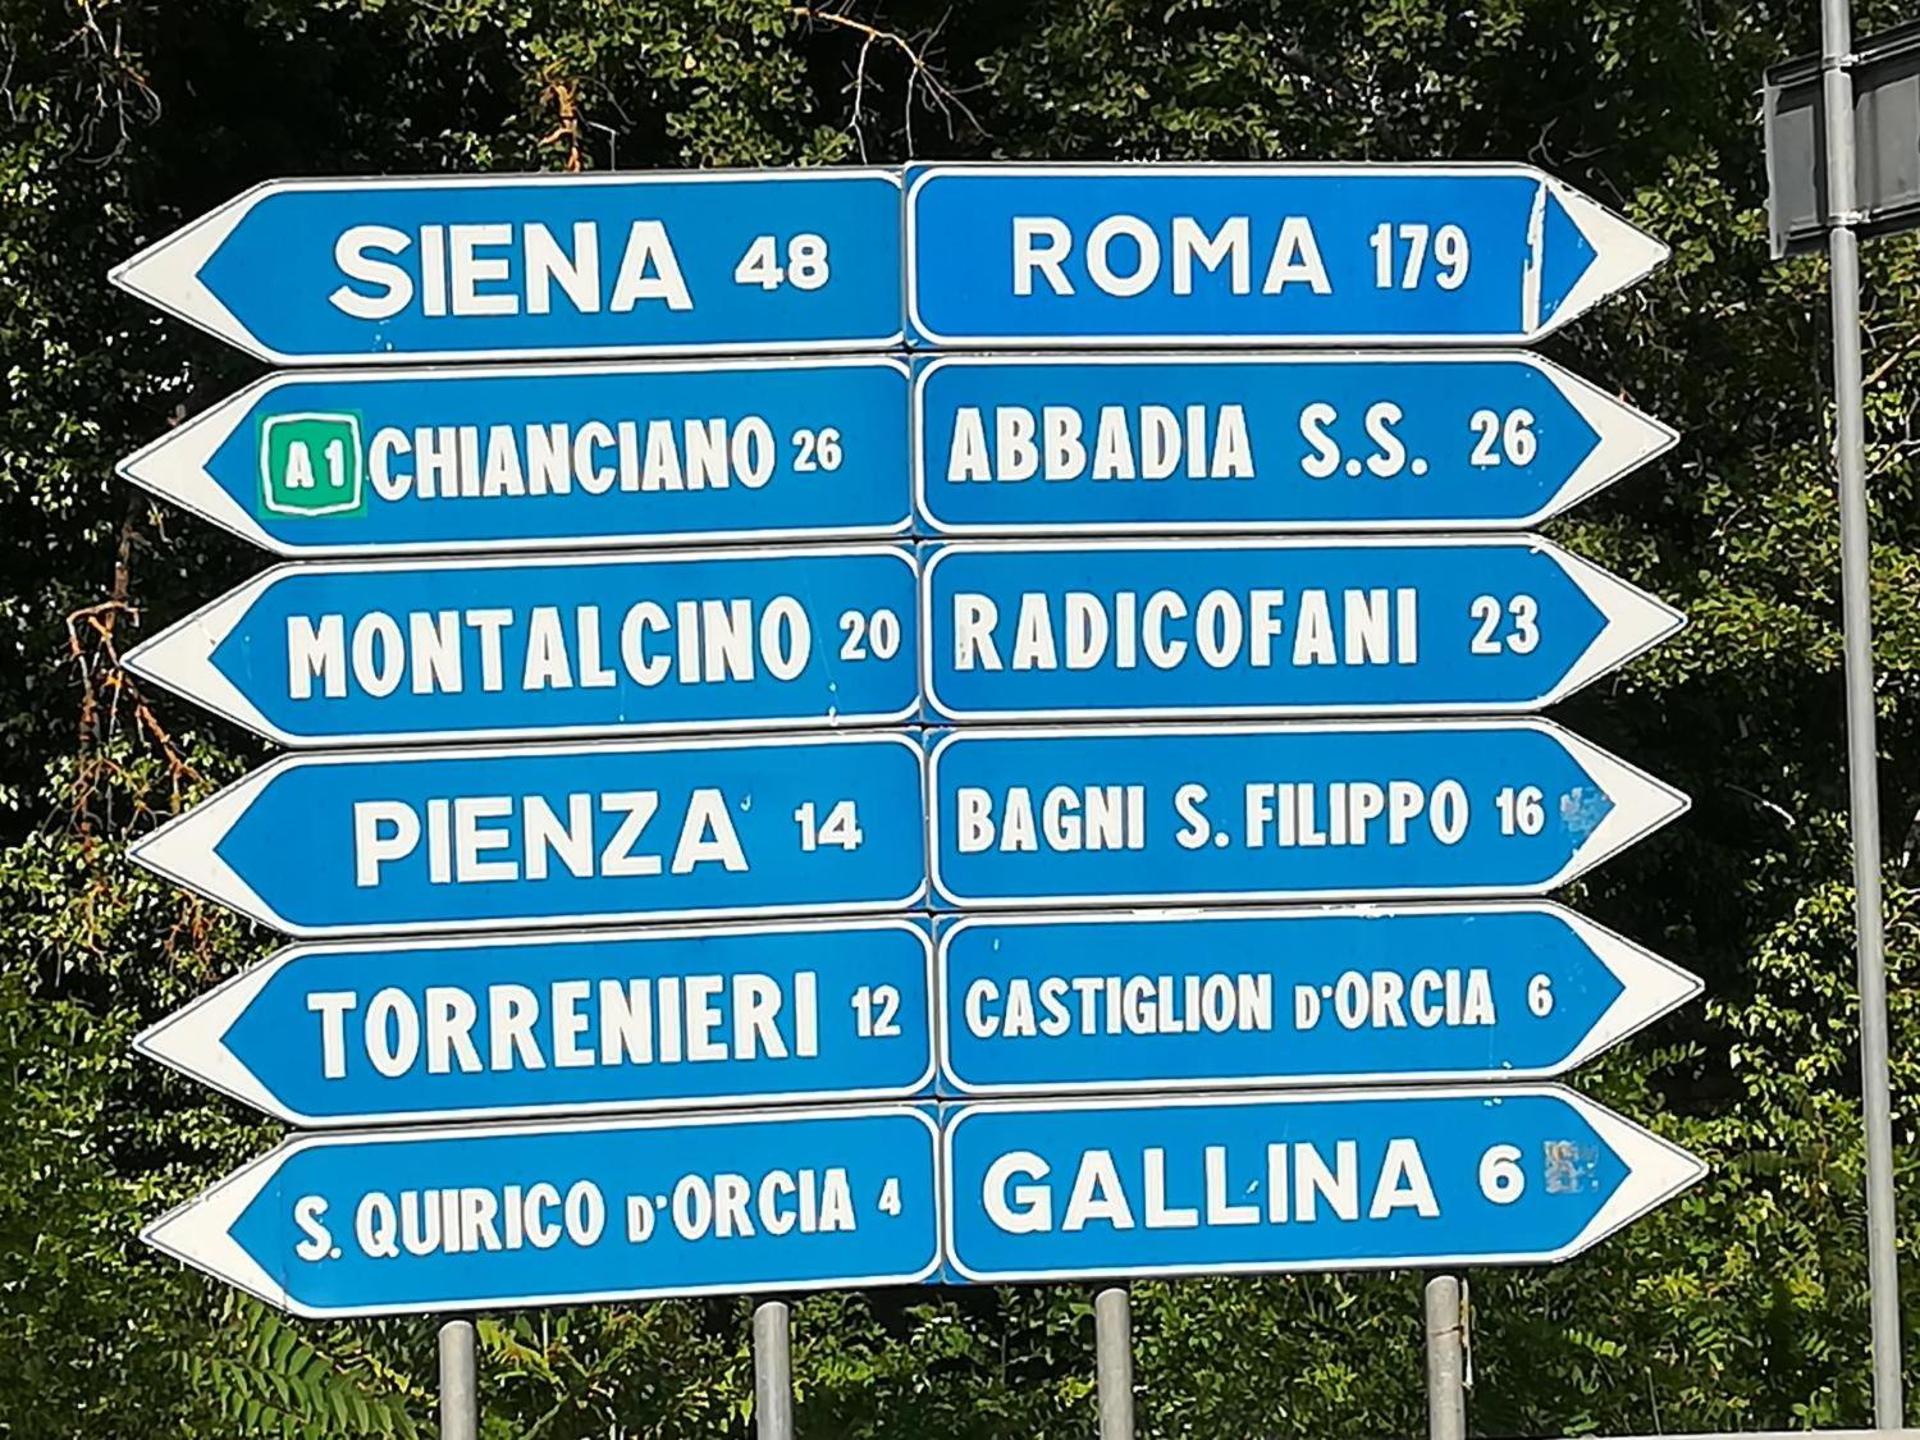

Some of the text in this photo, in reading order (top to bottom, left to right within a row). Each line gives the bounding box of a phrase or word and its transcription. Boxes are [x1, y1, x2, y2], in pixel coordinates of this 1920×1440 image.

[330, 222, 829, 319] SIENA 48
[1014, 216, 1469, 296] ROMA 179
[369, 417, 842, 502] CHIANCIANO 26
[948, 402, 1537, 482] ABBADIA S.S. 26
[287, 597, 900, 699] MONTALCINO 20
[954, 589, 1540, 671] RADICOFANI 23
[353, 789, 862, 887] PIENZA 14
[957, 781, 1545, 853] BAGNI S. FILIPPO 16
[307, 972, 901, 1079] TORRENIERI 12
[965, 974, 1272, 1038] CASTIGLION
[1529, 974, 1553, 1018] 6
[295, 1196, 341, 1262] S.
[356, 1180, 605, 1258] QUIRICO
[879, 1178, 901, 1217] 4
[984, 1138, 1525, 1234] GALLINA 6
